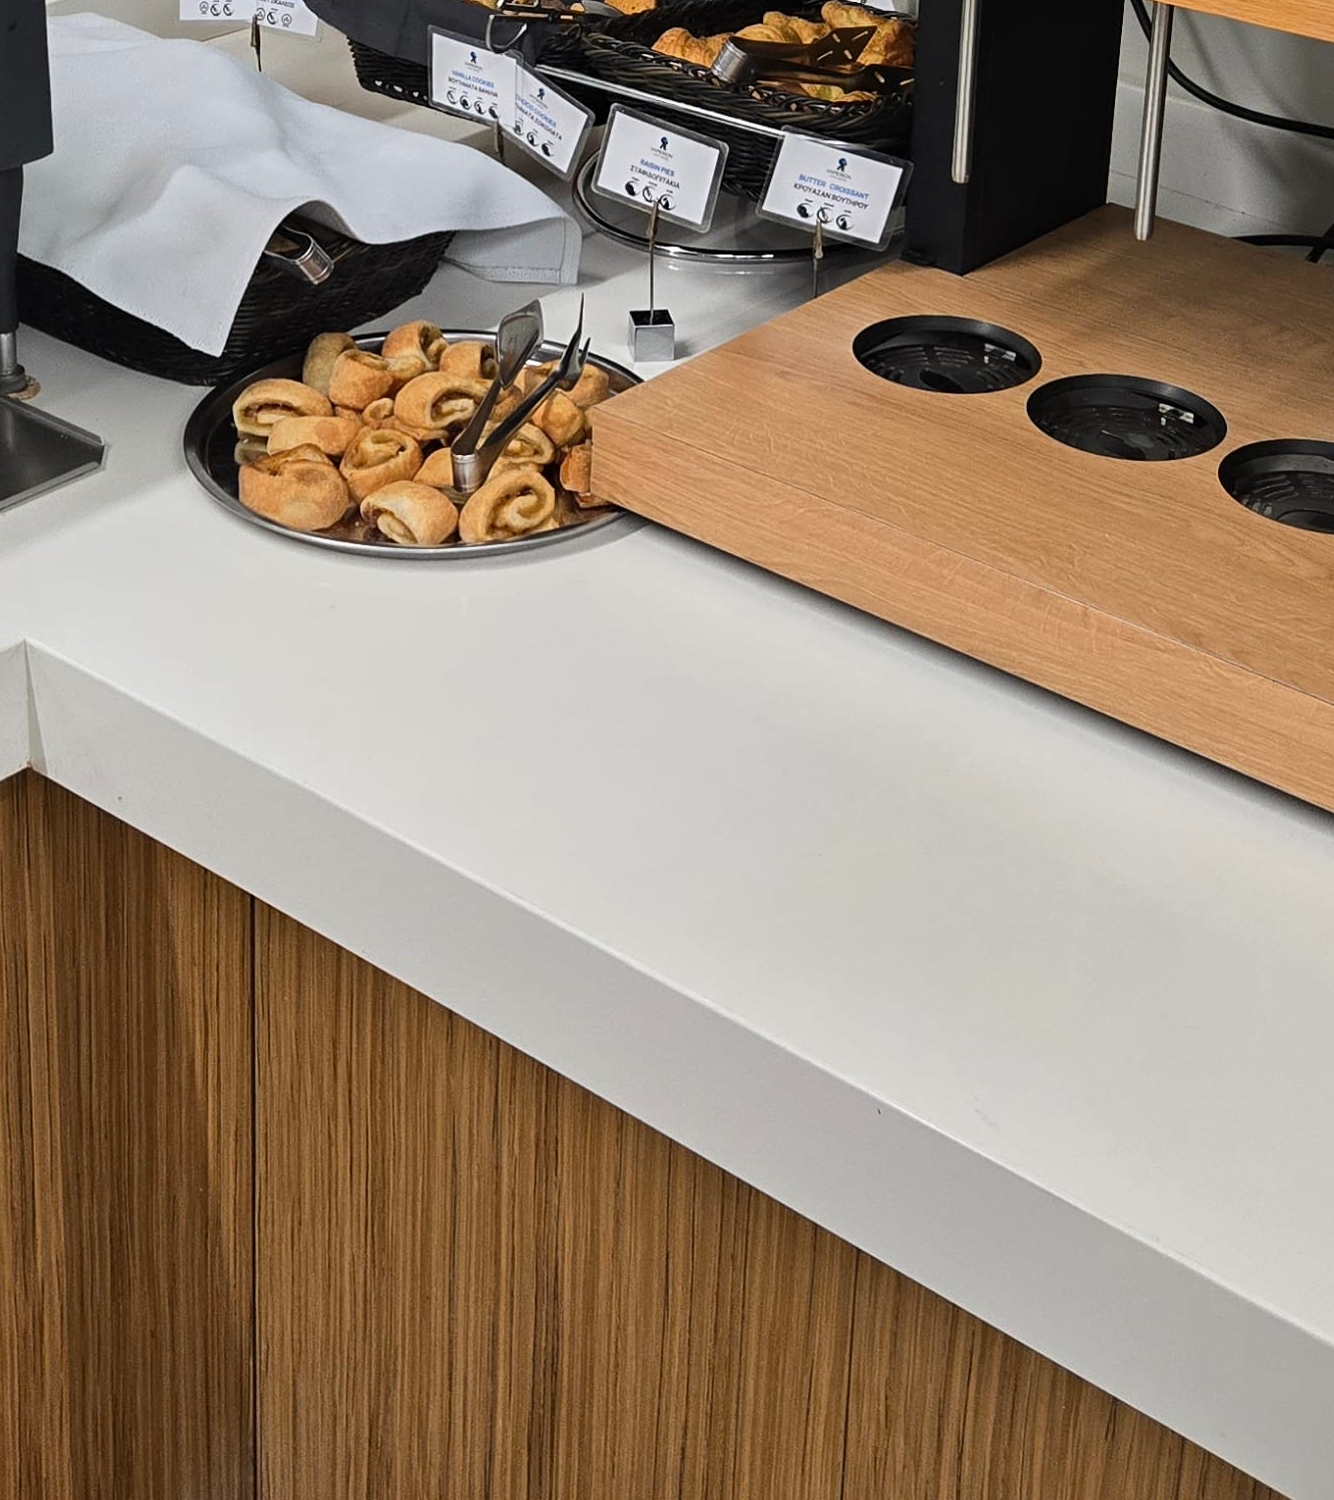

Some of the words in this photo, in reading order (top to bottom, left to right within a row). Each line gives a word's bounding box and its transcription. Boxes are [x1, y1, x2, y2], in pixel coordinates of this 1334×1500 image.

[639, 158, 661, 171] RAISIN
[660, 165, 675, 177] PIES
[798, 173, 827, 188] BUTTER
[828, 182, 870, 201] CROISSANT
